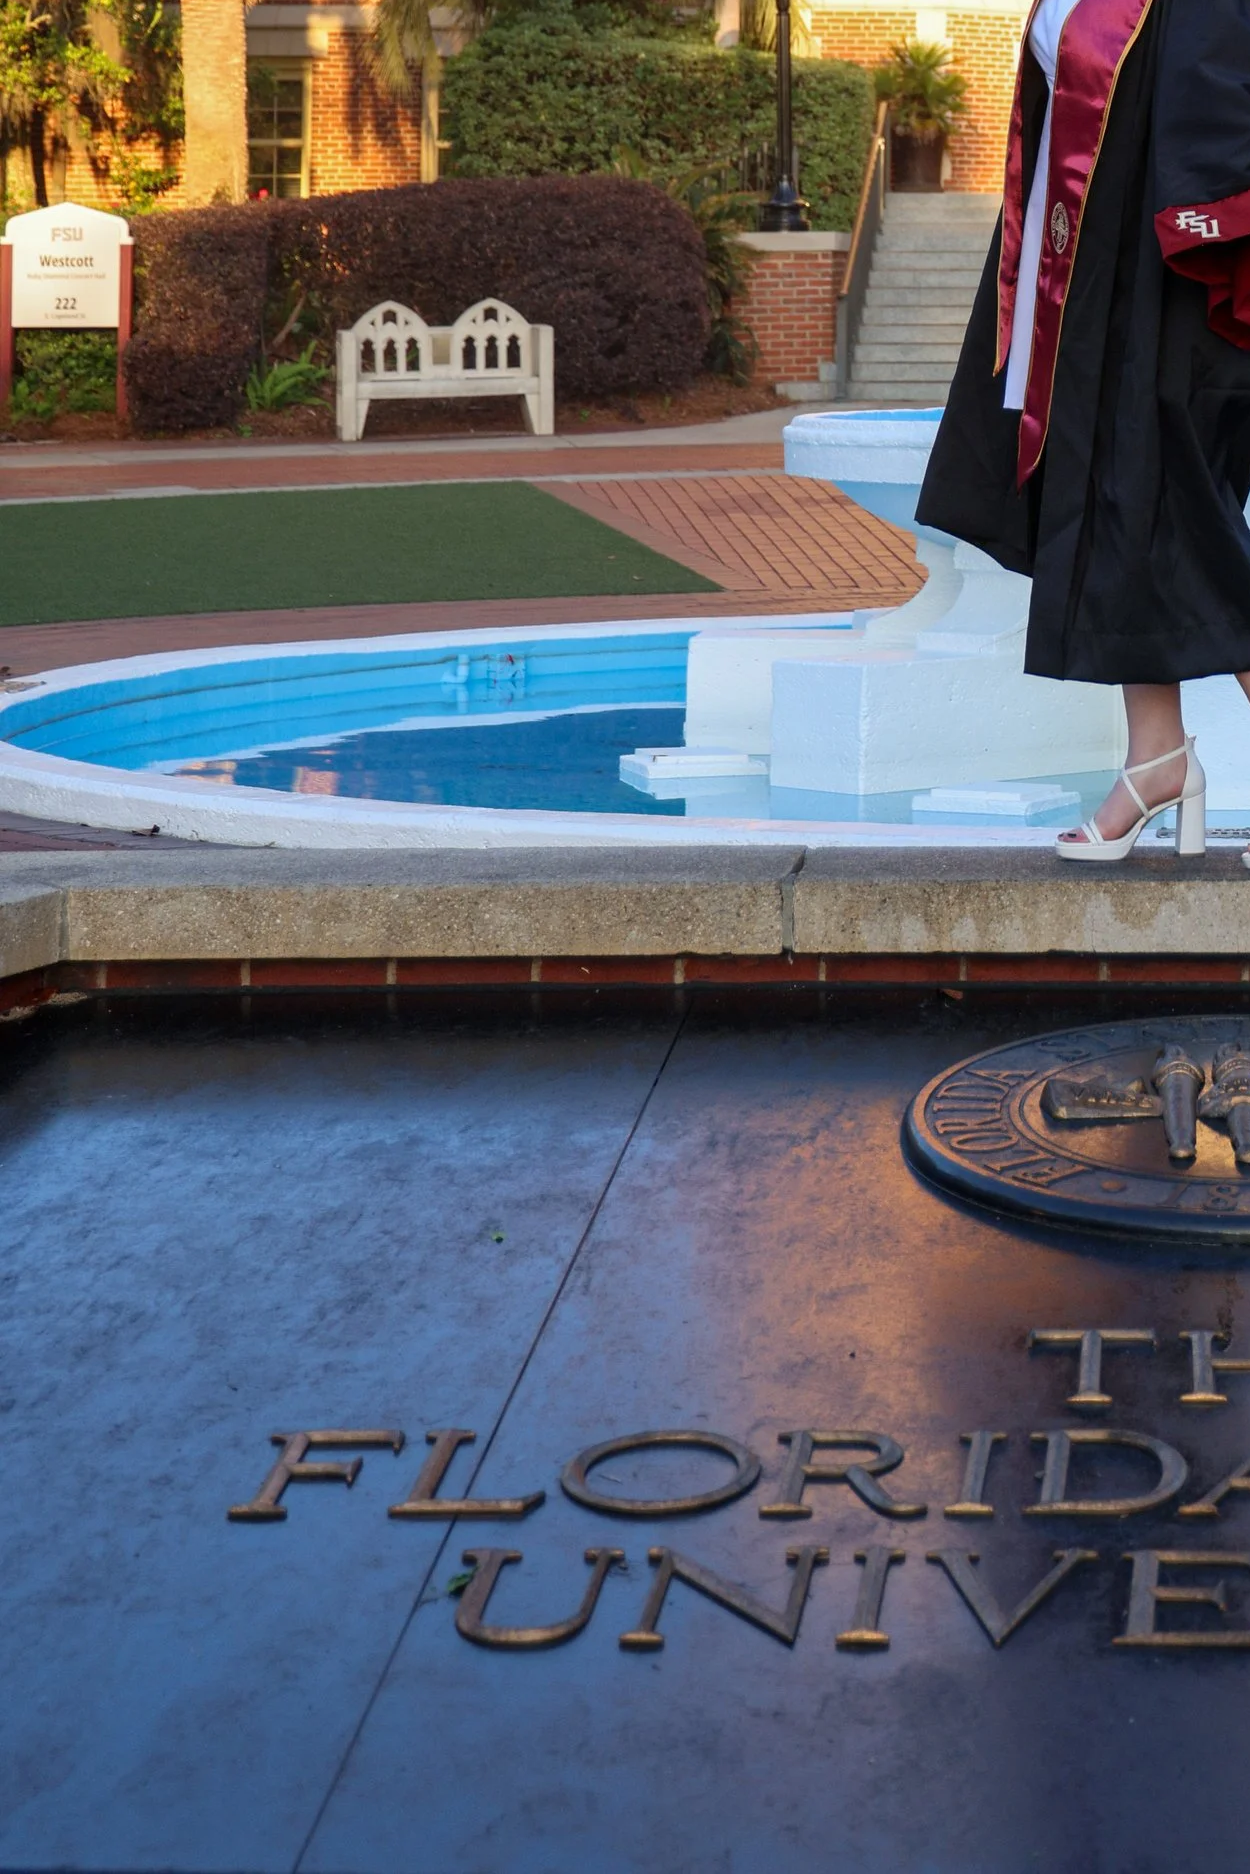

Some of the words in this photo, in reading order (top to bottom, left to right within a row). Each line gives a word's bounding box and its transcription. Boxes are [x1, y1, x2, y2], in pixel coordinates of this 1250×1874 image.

[1175, 210, 1221, 238] FSU
[51, 227, 83, 242] FSU
[39, 254, 94, 268] Westcott
[55, 297, 78, 311] 222
[933, 1069, 1090, 1187] FLORIDA
